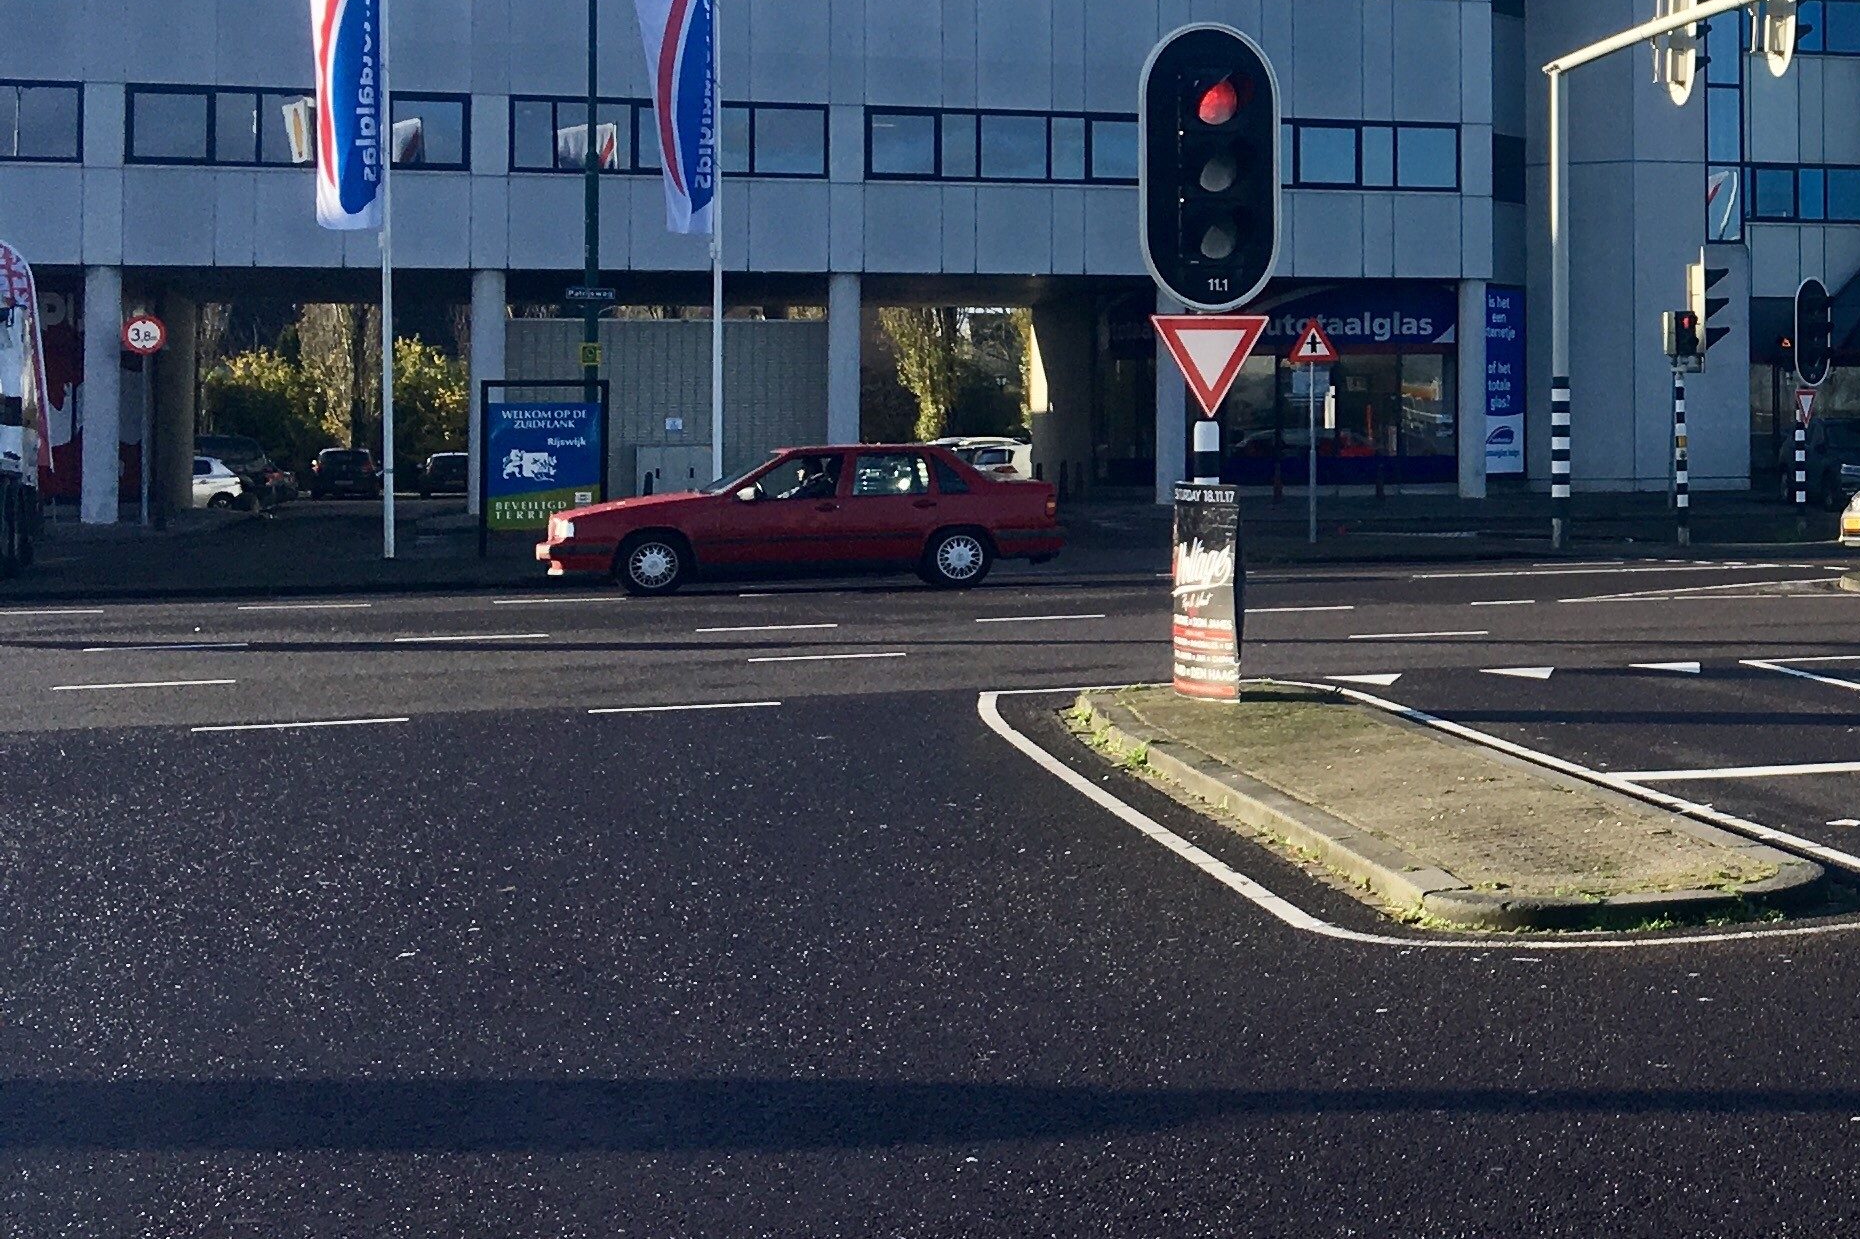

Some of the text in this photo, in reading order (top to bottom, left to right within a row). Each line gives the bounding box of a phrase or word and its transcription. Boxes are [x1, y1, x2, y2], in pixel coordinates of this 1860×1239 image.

[1207, 277, 1229, 292] 11.1
[501, 409, 587, 420] WELKOM OP DE
[546, 436, 587, 448] Rijswijk
[495, 500, 567, 510] BEVEILIGD
